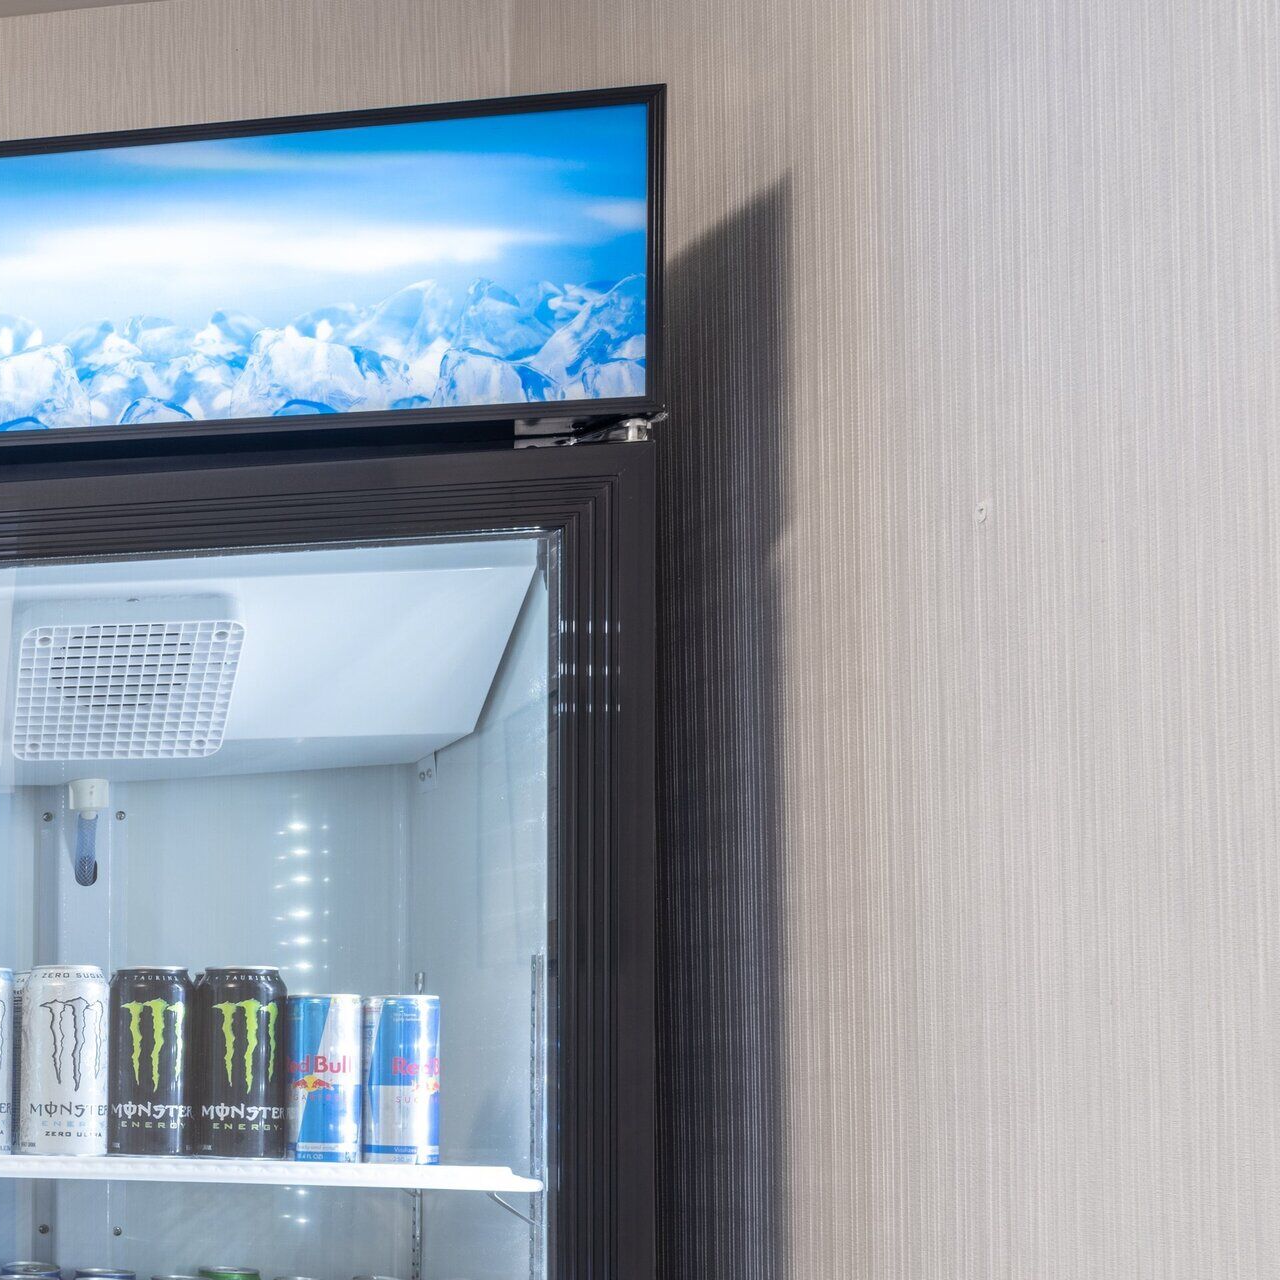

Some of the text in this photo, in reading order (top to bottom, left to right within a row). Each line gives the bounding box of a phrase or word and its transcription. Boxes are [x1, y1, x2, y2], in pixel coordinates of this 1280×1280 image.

[30, 1103, 107, 1117] MONSTER
[111, 1101, 193, 1120] MONSTER
[201, 1102, 284, 1120] MONSTER
[121, 1120, 186, 1129] ENERGY
[212, 1122, 279, 1132] ENERGY
